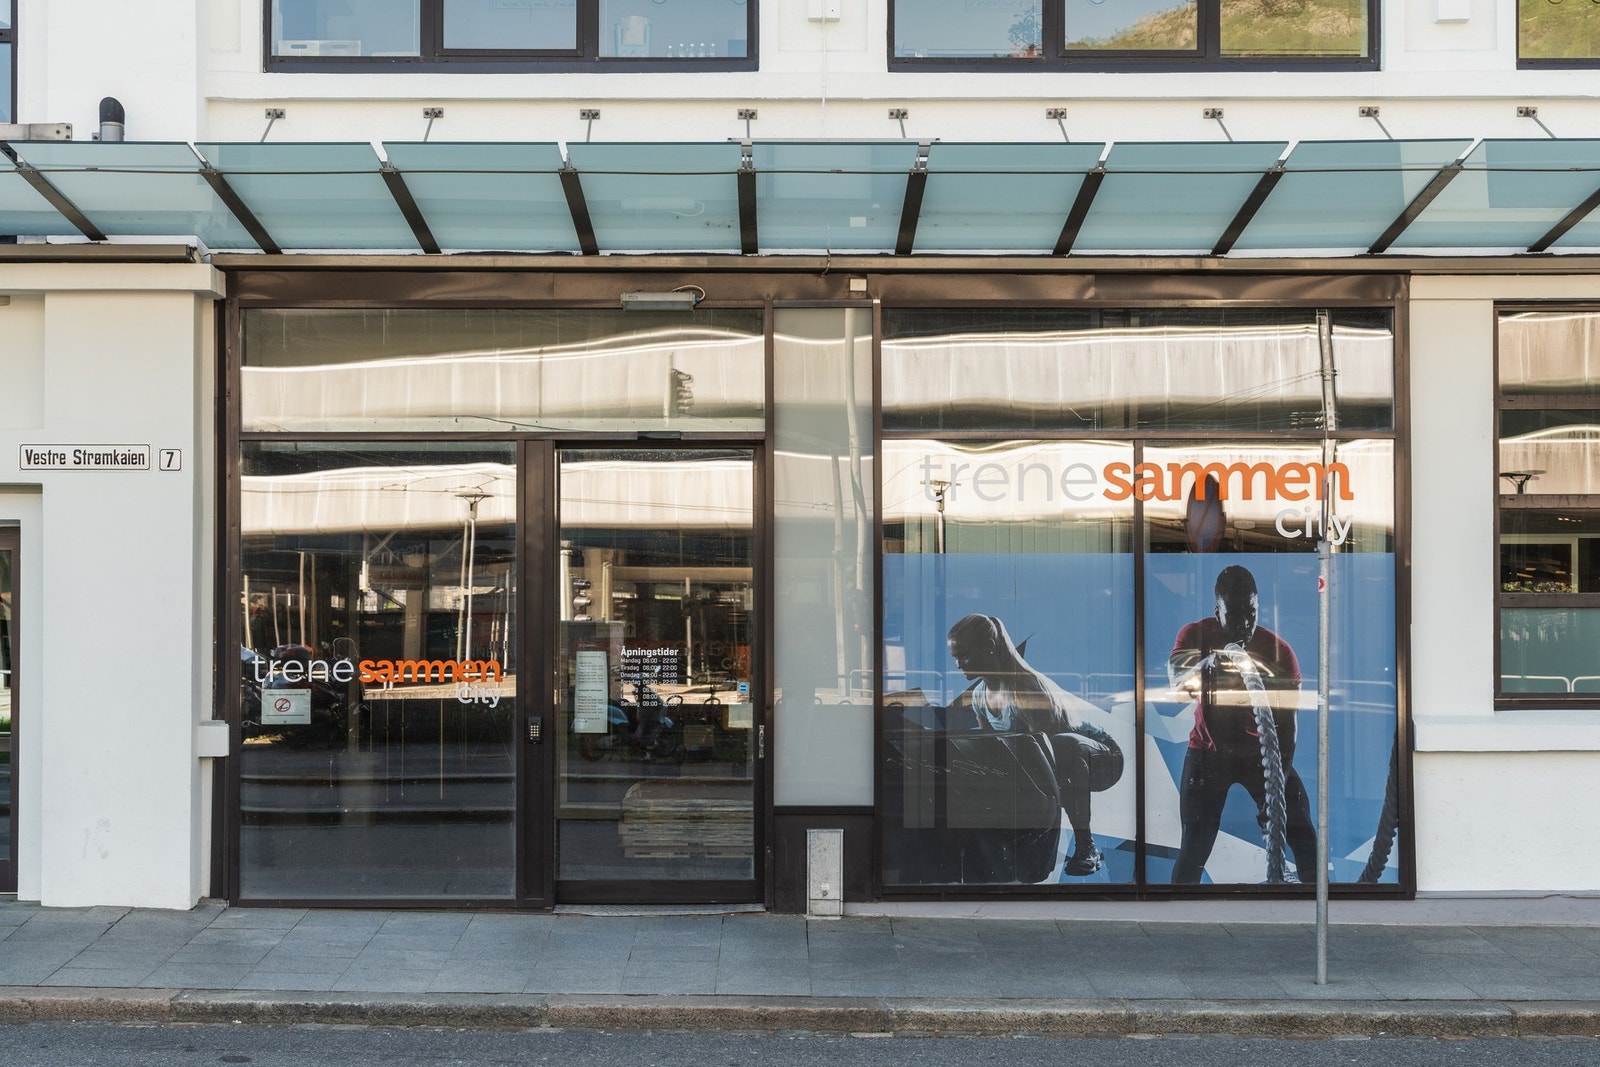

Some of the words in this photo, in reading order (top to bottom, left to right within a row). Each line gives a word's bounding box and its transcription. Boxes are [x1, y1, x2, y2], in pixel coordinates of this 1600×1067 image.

[25, 449, 66, 465] Vestre
[73, 449, 145, 465] Strømkaien
[166, 452, 174, 468] 7
[620, 645, 679, 657] Åpningstider
[620, 657, 641, 665] Mandag
[457, 684, 503, 709] City
